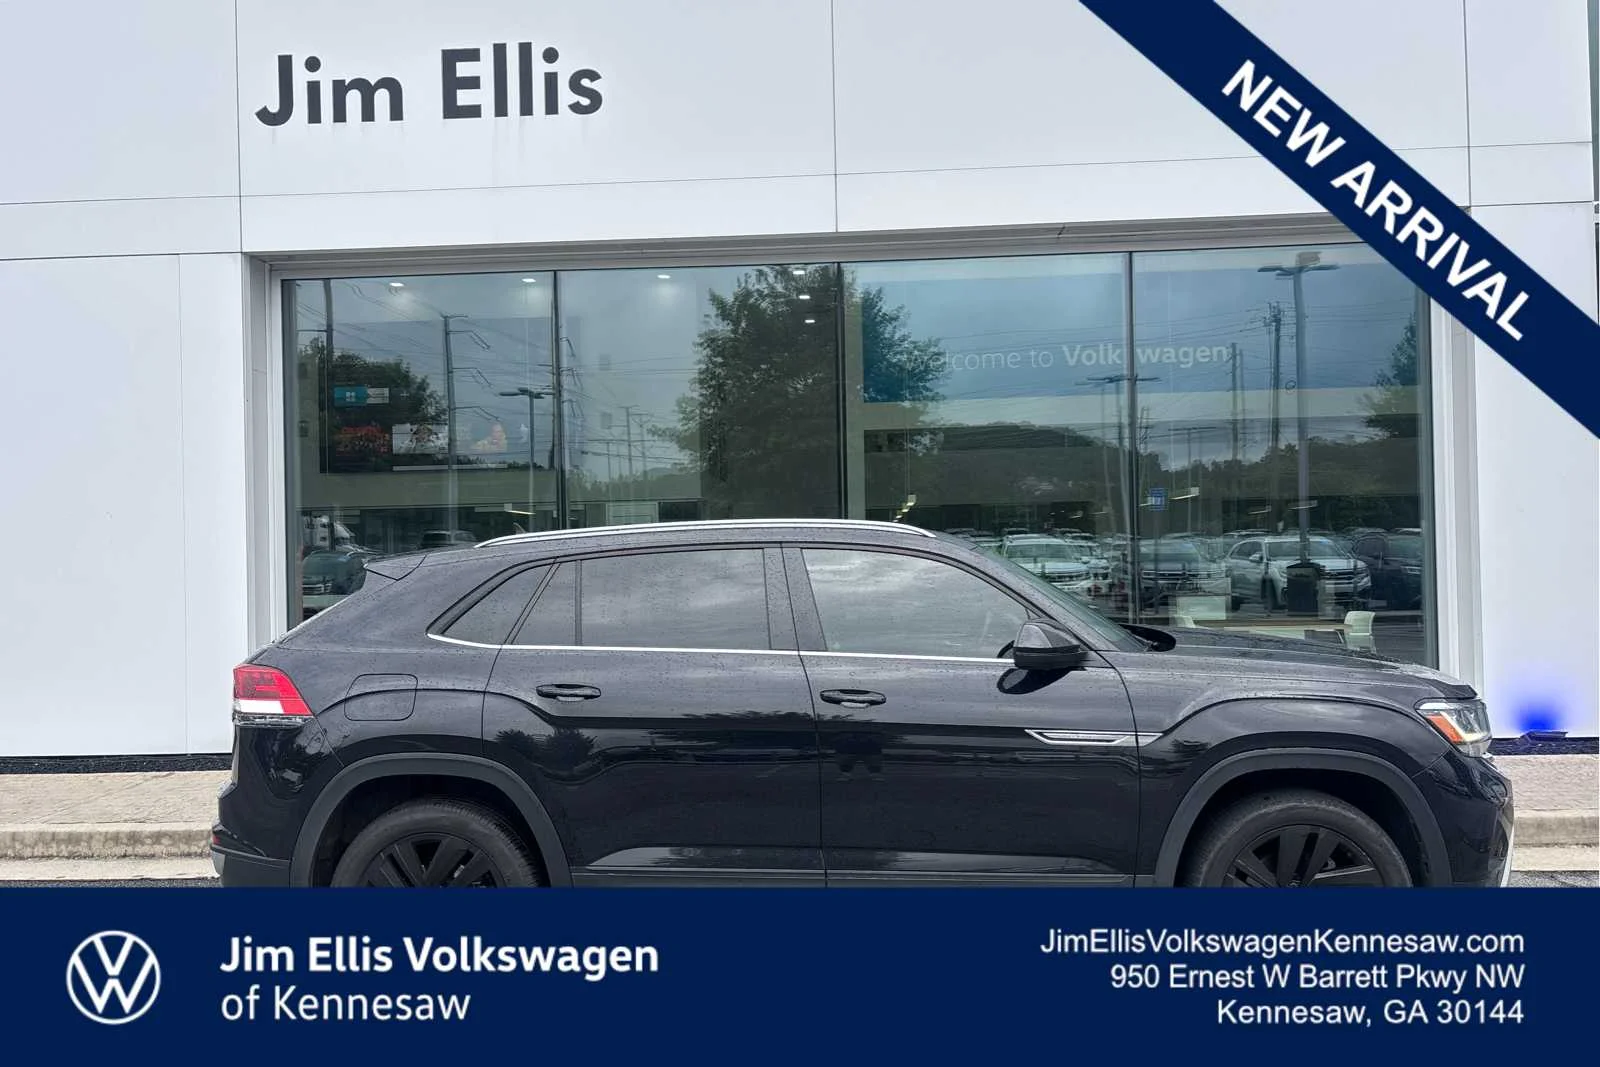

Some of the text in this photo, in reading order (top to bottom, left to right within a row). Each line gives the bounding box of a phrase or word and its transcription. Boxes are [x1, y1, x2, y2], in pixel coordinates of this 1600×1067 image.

[255, 42, 603, 127] Jim Ellis
[1030, 348, 1055, 368] to
[1062, 343, 1230, 369] Volkwagen
